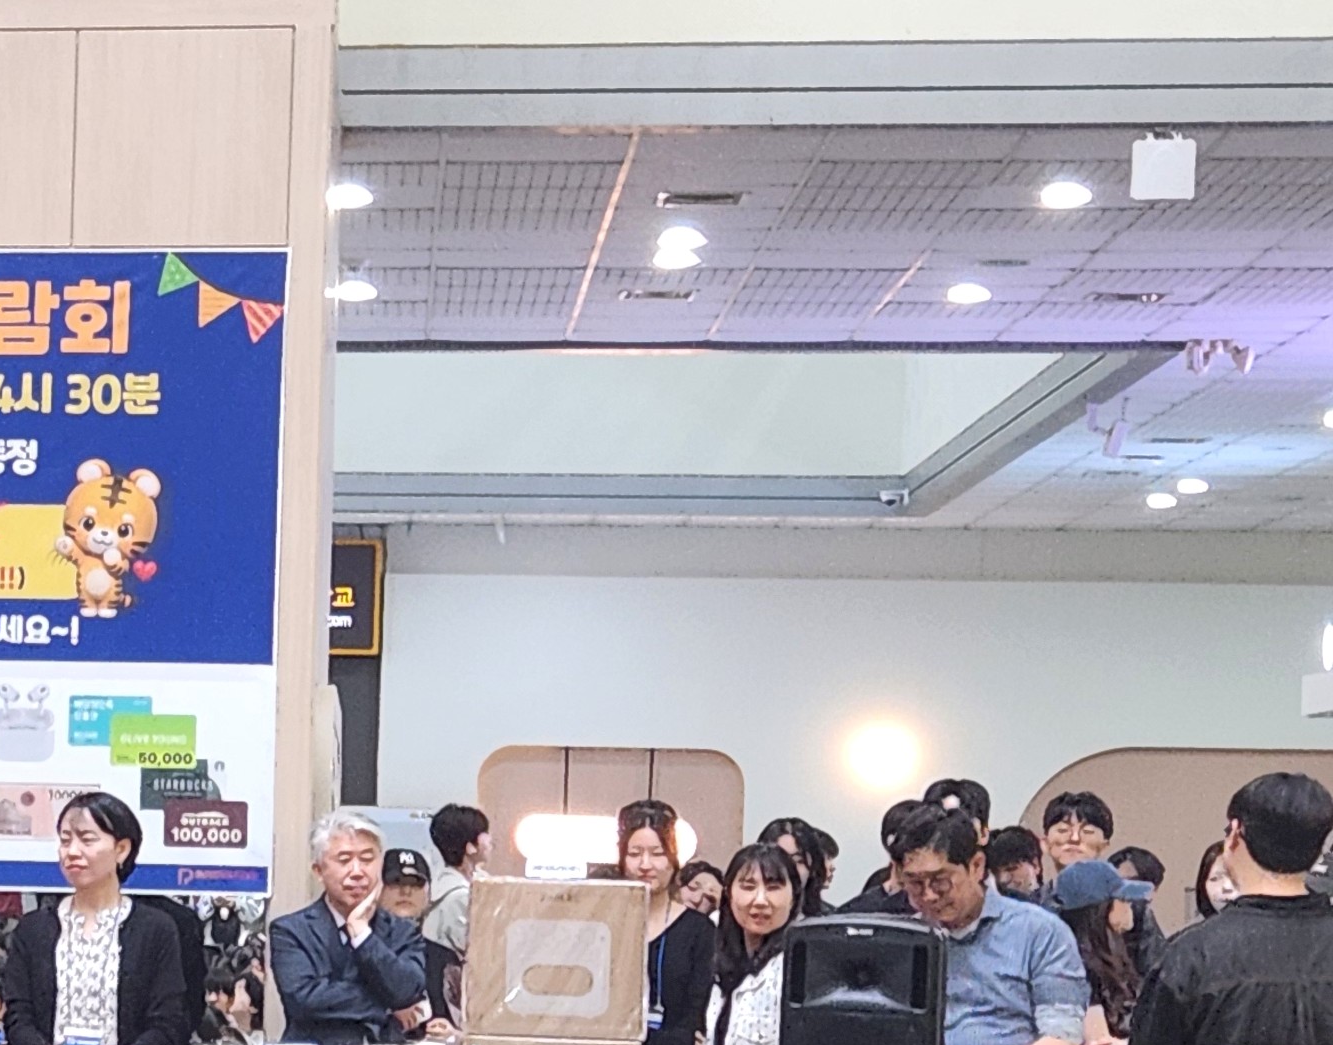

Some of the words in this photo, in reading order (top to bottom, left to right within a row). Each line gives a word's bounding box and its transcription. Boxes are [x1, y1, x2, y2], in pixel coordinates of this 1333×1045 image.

[64, 372, 162, 415] 30분
[138, 752, 193, 766] 50,000
[153, 777, 214, 791] STARBUCKS
[171, 827, 242, 845] 100,000
